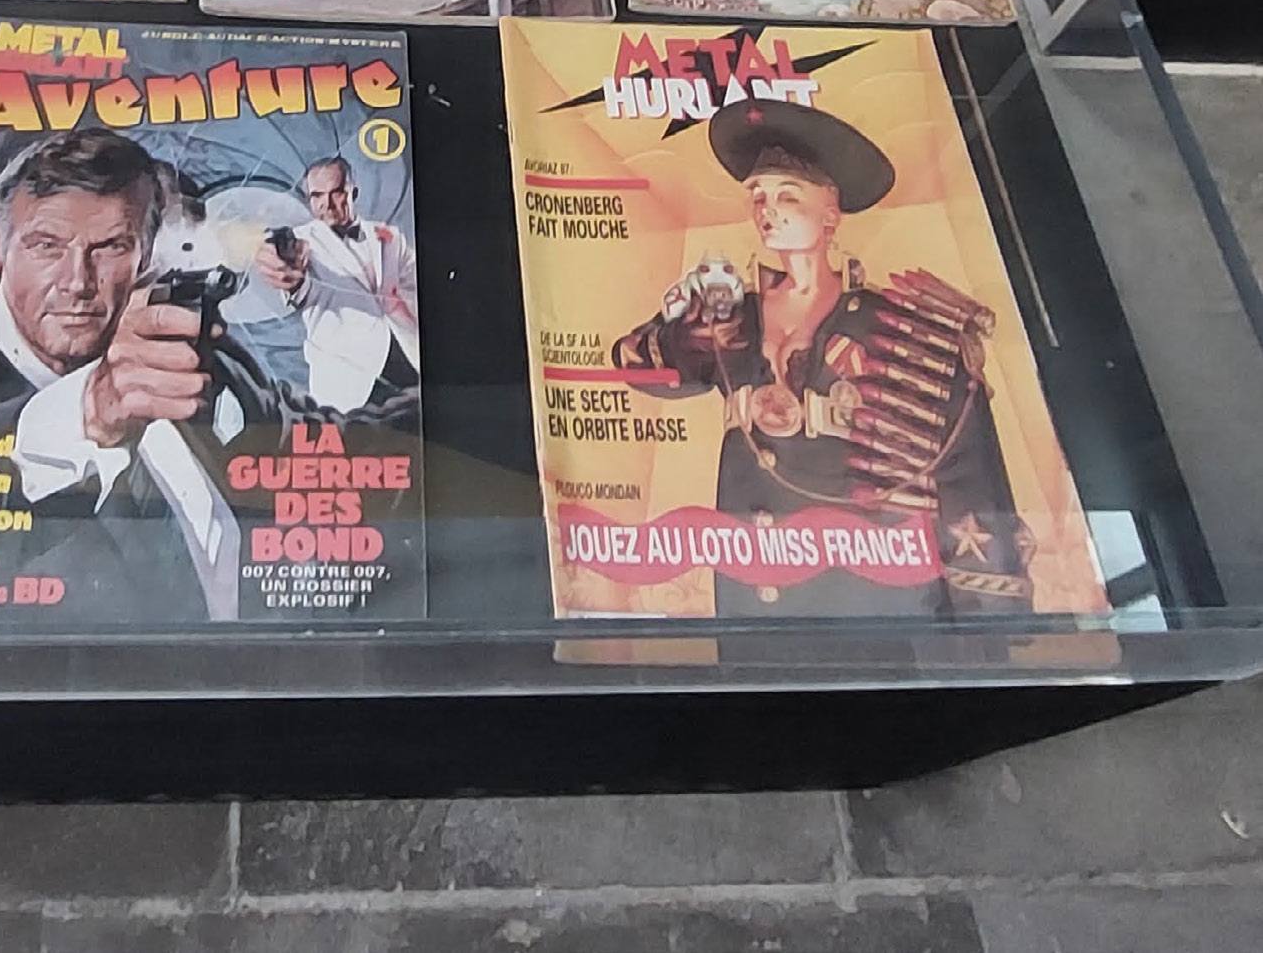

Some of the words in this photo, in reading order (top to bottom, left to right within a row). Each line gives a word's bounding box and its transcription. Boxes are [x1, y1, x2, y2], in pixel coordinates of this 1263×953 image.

[613, 32, 810, 88] METAL
[370, 127, 388, 153] 1
[525, 191, 624, 216] CRONENBERG
[528, 214, 558, 239] FAIT
[563, 218, 630, 240] MOUCHE
[540, 332, 551, 346] DE
[553, 333, 565, 347] LA
[580, 334, 587, 347] A
[589, 334, 601, 347] LA
[542, 349, 605, 366] SCIENTOLOGIE
[545, 386, 577, 412] UNE
[580, 390, 632, 414] SECTE
[292, 423, 346, 454] LA
[548, 414, 569, 439] EN
[572, 418, 630, 442] ORBITE
[634, 418, 689, 443] BASSE
[227, 455, 411, 490] GUERRE
[274, 491, 363, 526] DES
[251, 526, 384, 563] BOND
[566, 523, 642, 564] JOUEZ
[647, 526, 683, 566] AU
[687, 527, 753, 566] LOTO
[756, 527, 820, 568] MISS
[242, 565, 274, 579] 007
[278, 565, 351, 579] CONTRE
[354, 565, 391, 581] 007,
[261, 579, 287, 593] UN
[293, 579, 372, 593] DOSSIER
[13, 577, 65, 605] BD
[266, 594, 357, 608] EXPLOSIF
